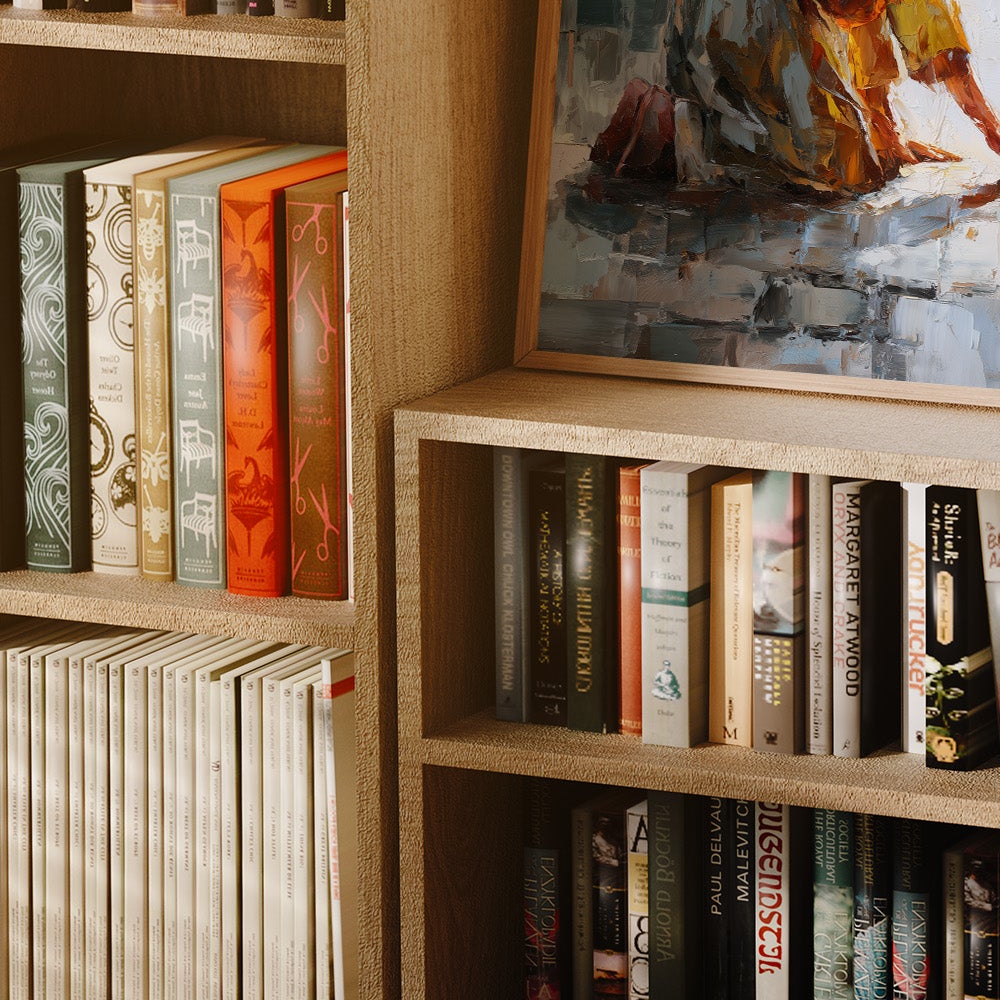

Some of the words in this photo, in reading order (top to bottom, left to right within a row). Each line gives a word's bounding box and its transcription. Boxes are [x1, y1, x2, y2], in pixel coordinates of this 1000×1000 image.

[502, 455, 514, 528] DOWNTOWN
[833, 492, 846, 543] ORYX
[502, 531, 514, 557] OWL
[834, 551, 845, 592] AND
[846, 493, 860, 607] MARGARET
[502, 609, 514, 690] KLOSTERMAN
[834, 601, 846, 669] CRAKE
[845, 611, 860, 697] ATWOOD
[710, 798, 722, 865] DELVAU
[710, 871, 722, 915] PAUL
